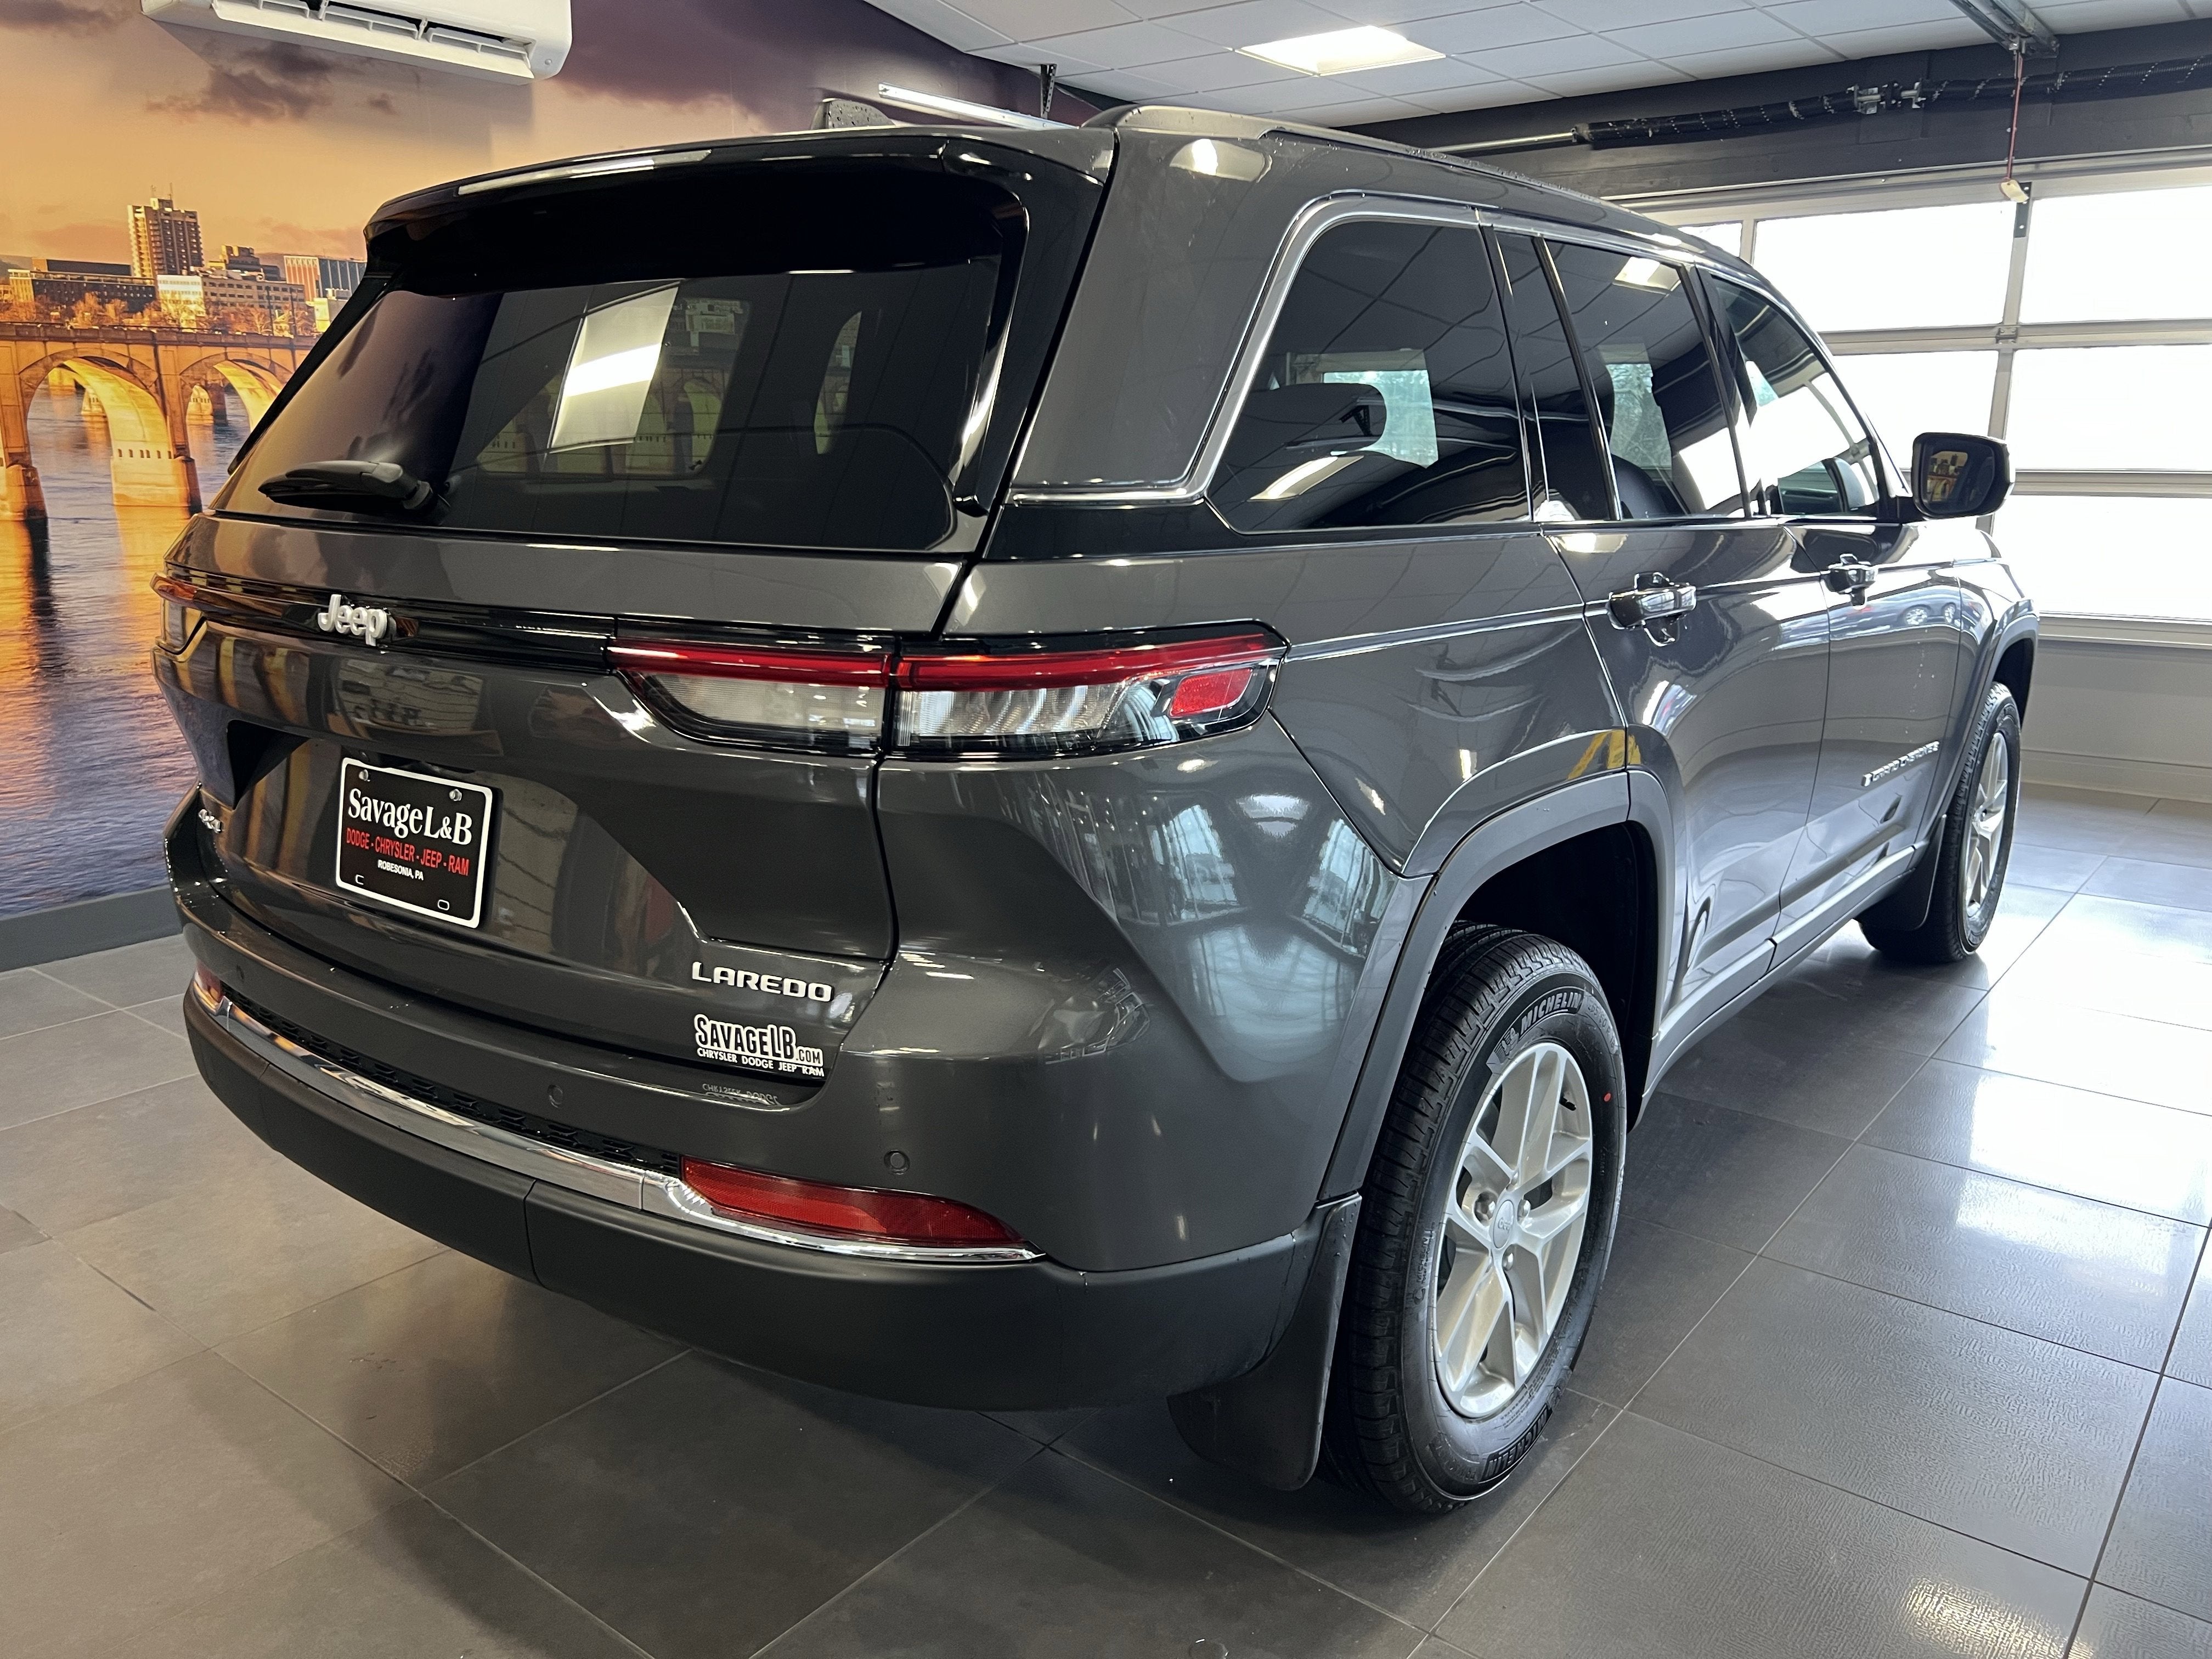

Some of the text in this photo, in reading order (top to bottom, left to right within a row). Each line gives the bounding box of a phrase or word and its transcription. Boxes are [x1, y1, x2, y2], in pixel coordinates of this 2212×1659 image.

[318, 594, 387, 647] Jeep
[346, 828, 470, 876] DODGE CHRYSLER JEEP RAM
[414, 870, 424, 881] PA
[692, 961, 833, 1002] LAREDO
[1520, 992, 1582, 1035] MICHELIN
[697, 1048, 825, 1077] CHRYSLER DODGE JEEP RAM
[1417, 1237, 1429, 1283] MICHELIN
[1485, 1407, 1548, 1479] MICHELIN
